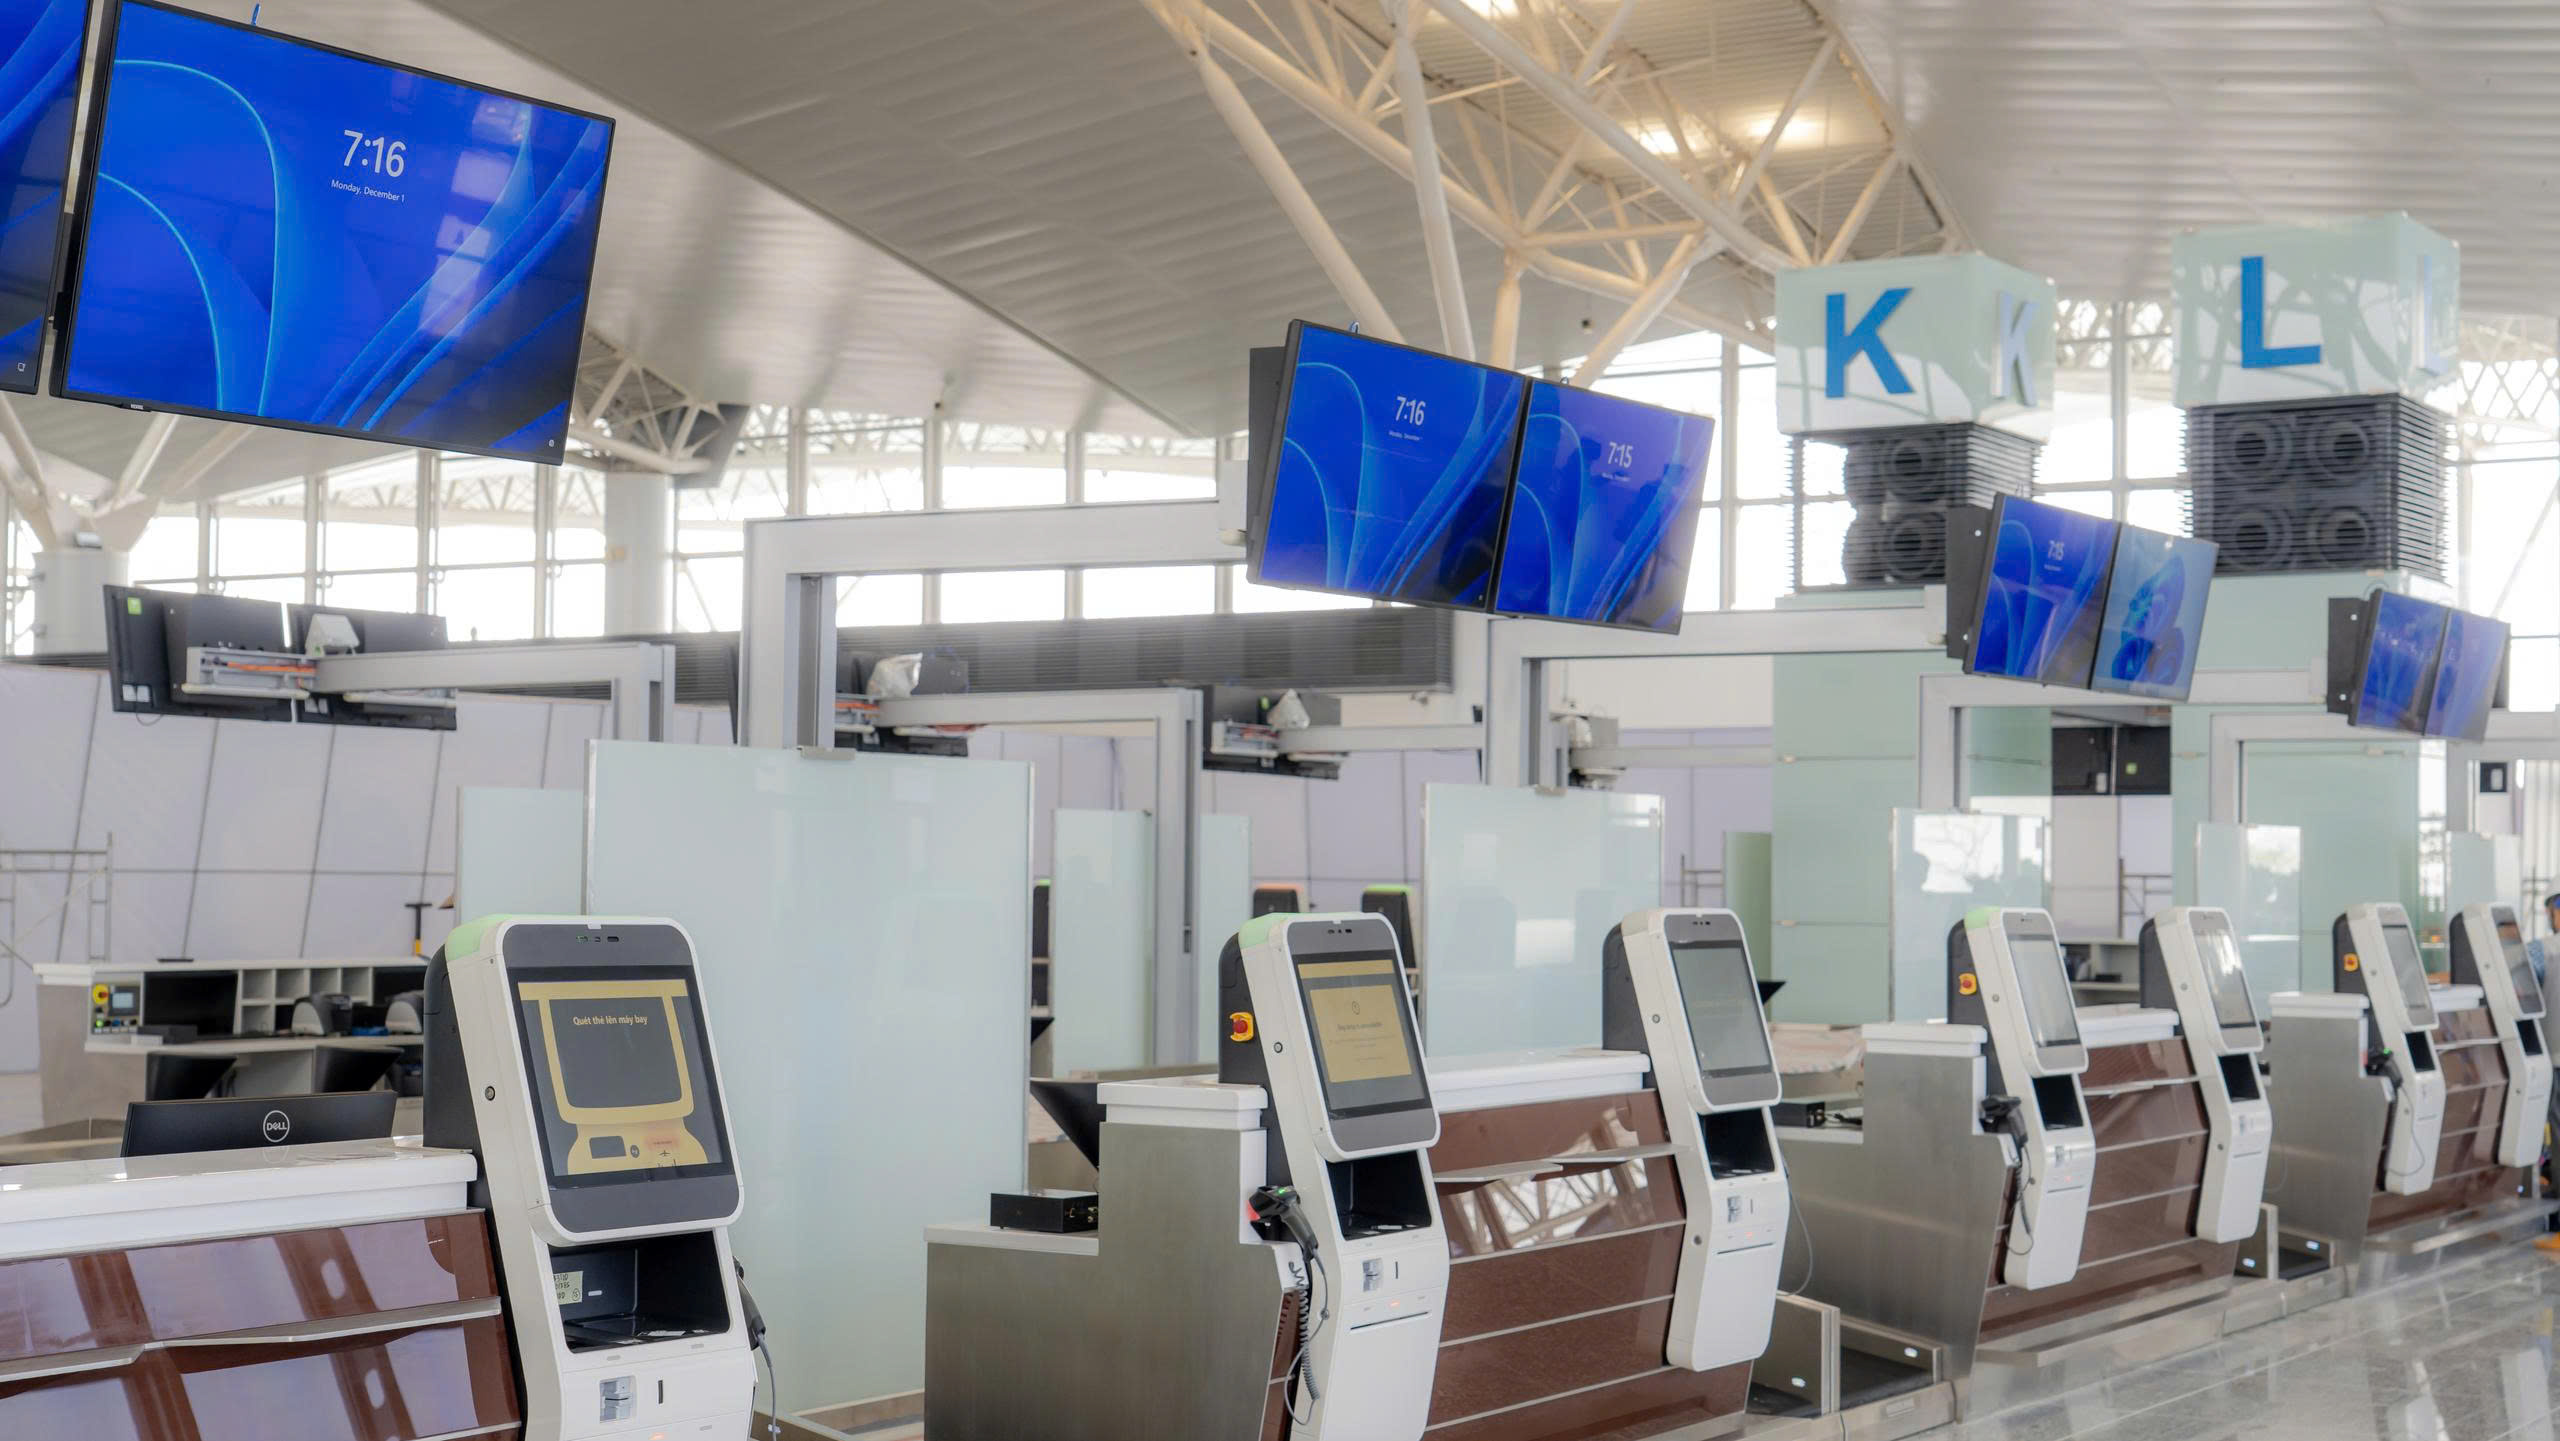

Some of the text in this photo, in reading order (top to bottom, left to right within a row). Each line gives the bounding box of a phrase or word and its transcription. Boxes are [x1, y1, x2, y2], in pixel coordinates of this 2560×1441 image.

[344, 129, 406, 178] 7:16
[331, 179, 362, 195] Monday,
[364, 186, 400, 201] December
[2241, 256, 2321, 369] L
[1825, 287, 1914, 398] K
[1992, 290, 2040, 407] K
[1395, 396, 1426, 426] 7:16
[1608, 441, 1633, 468] 7:15
[573, 1016, 591, 1025] Quét
[634, 1014, 647, 1025] bay
[266, 1121, 288, 1131] DELL
